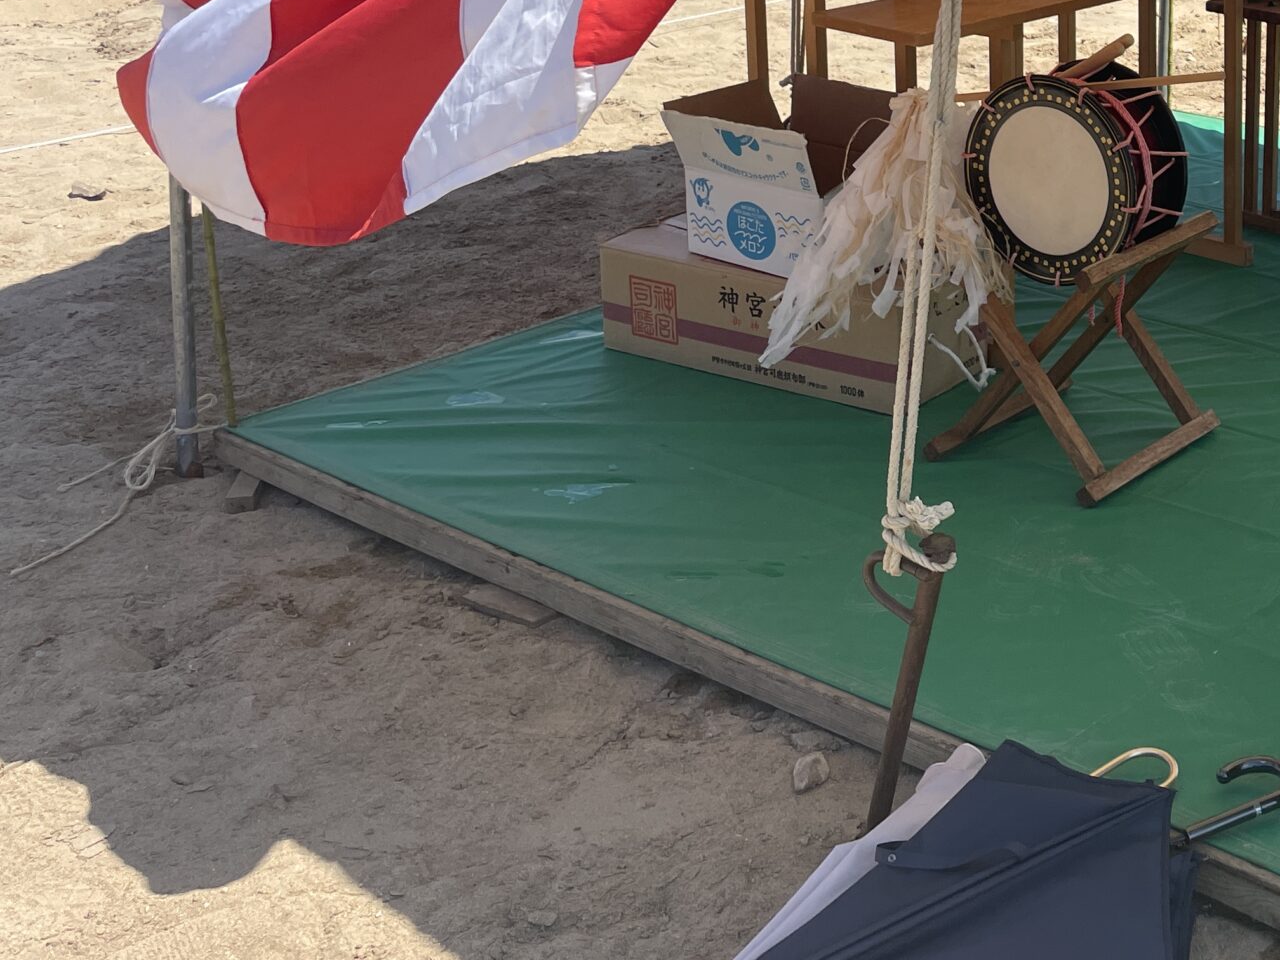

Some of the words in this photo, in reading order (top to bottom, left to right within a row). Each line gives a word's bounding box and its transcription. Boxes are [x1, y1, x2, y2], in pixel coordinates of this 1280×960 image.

[738, 215, 765, 235] ほこた
[739, 239, 765, 254] メロン
